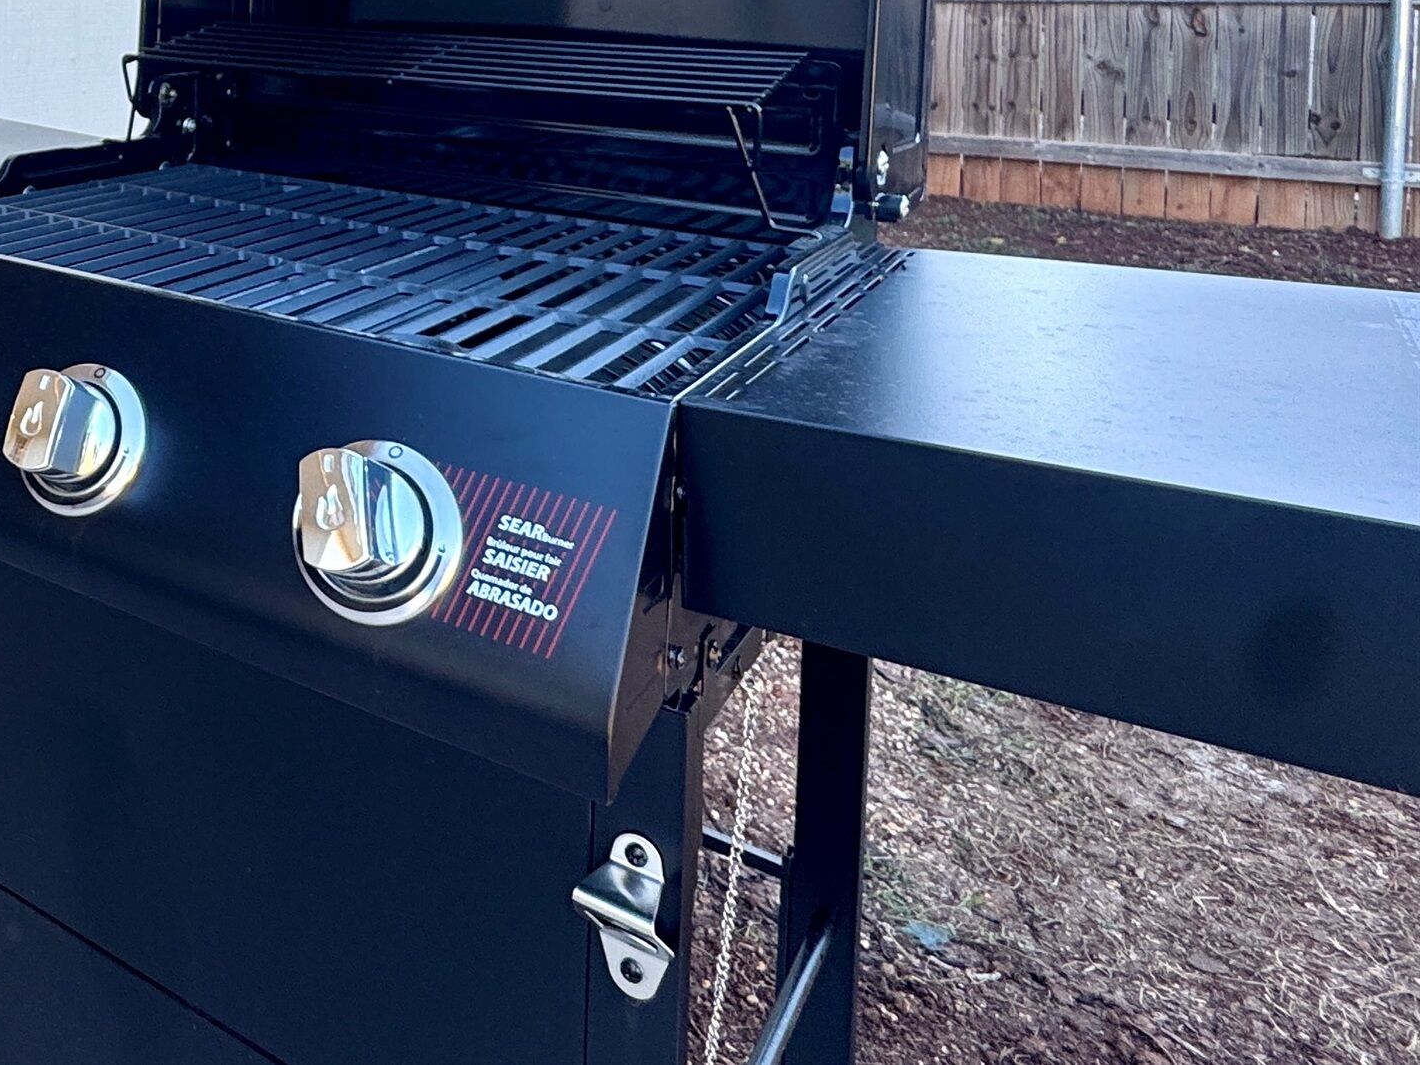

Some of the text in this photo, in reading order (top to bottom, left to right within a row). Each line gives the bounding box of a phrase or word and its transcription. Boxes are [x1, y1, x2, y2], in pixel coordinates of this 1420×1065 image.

[482, 548, 551, 583] SAISIER
[520, 548, 544, 562] pour
[465, 580, 558, 621] ABRASADO
[519, 584, 533, 596] de
